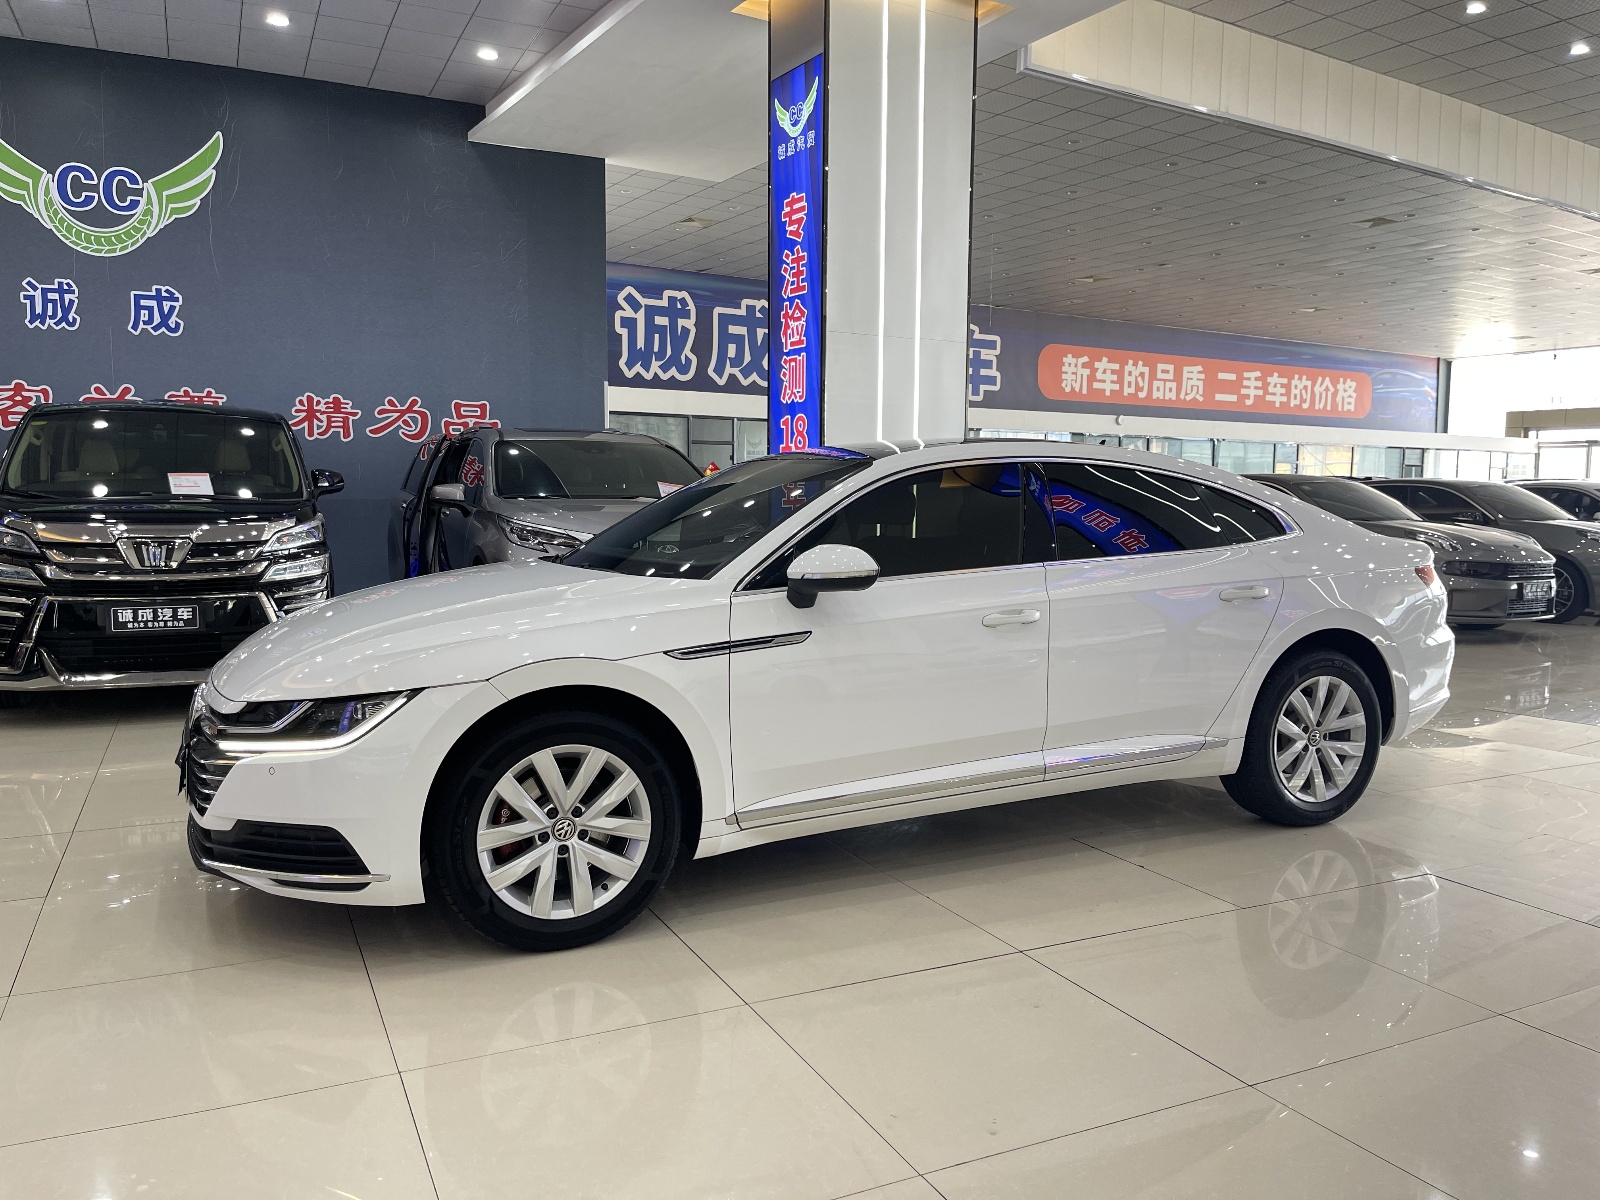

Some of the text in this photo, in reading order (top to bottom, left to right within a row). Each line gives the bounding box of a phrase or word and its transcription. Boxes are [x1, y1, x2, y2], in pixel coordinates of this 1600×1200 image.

[55, 162, 146, 215] CC
[21, 277, 184, 336] 诚成
[1061, 354, 1357, 412] 新车的品质 二手车的价格
[117, 608, 193, 622] 诚成汽车
